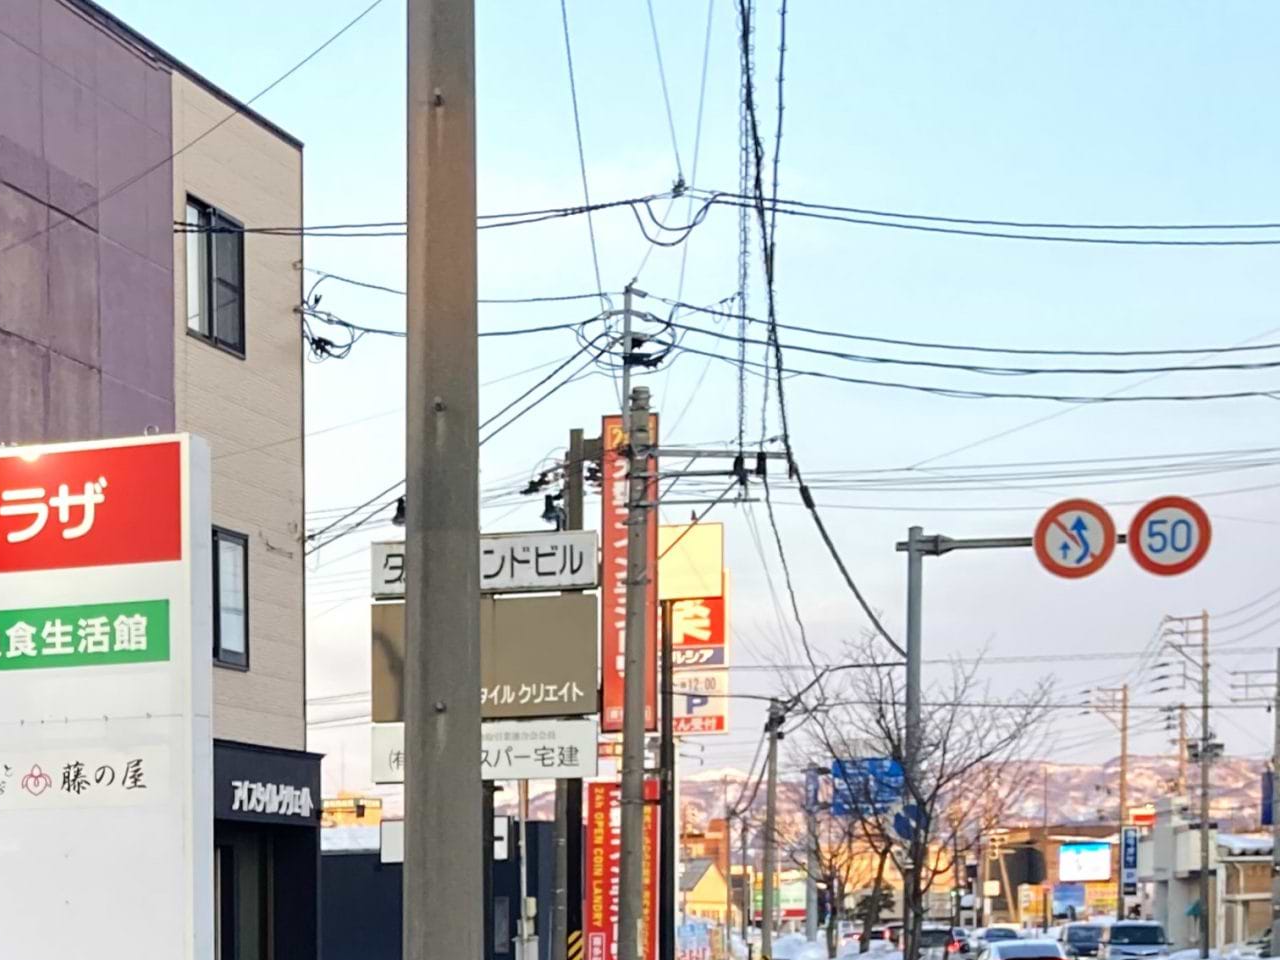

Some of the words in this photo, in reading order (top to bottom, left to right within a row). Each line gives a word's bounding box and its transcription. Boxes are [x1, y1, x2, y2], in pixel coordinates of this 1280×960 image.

[1147, 518, 1193, 553] 50
[686, 696, 709, 715] P
[60, 758, 148, 795] 藤の屋
[593, 811, 605, 845] OPEN
[592, 847, 604, 877] COIN
